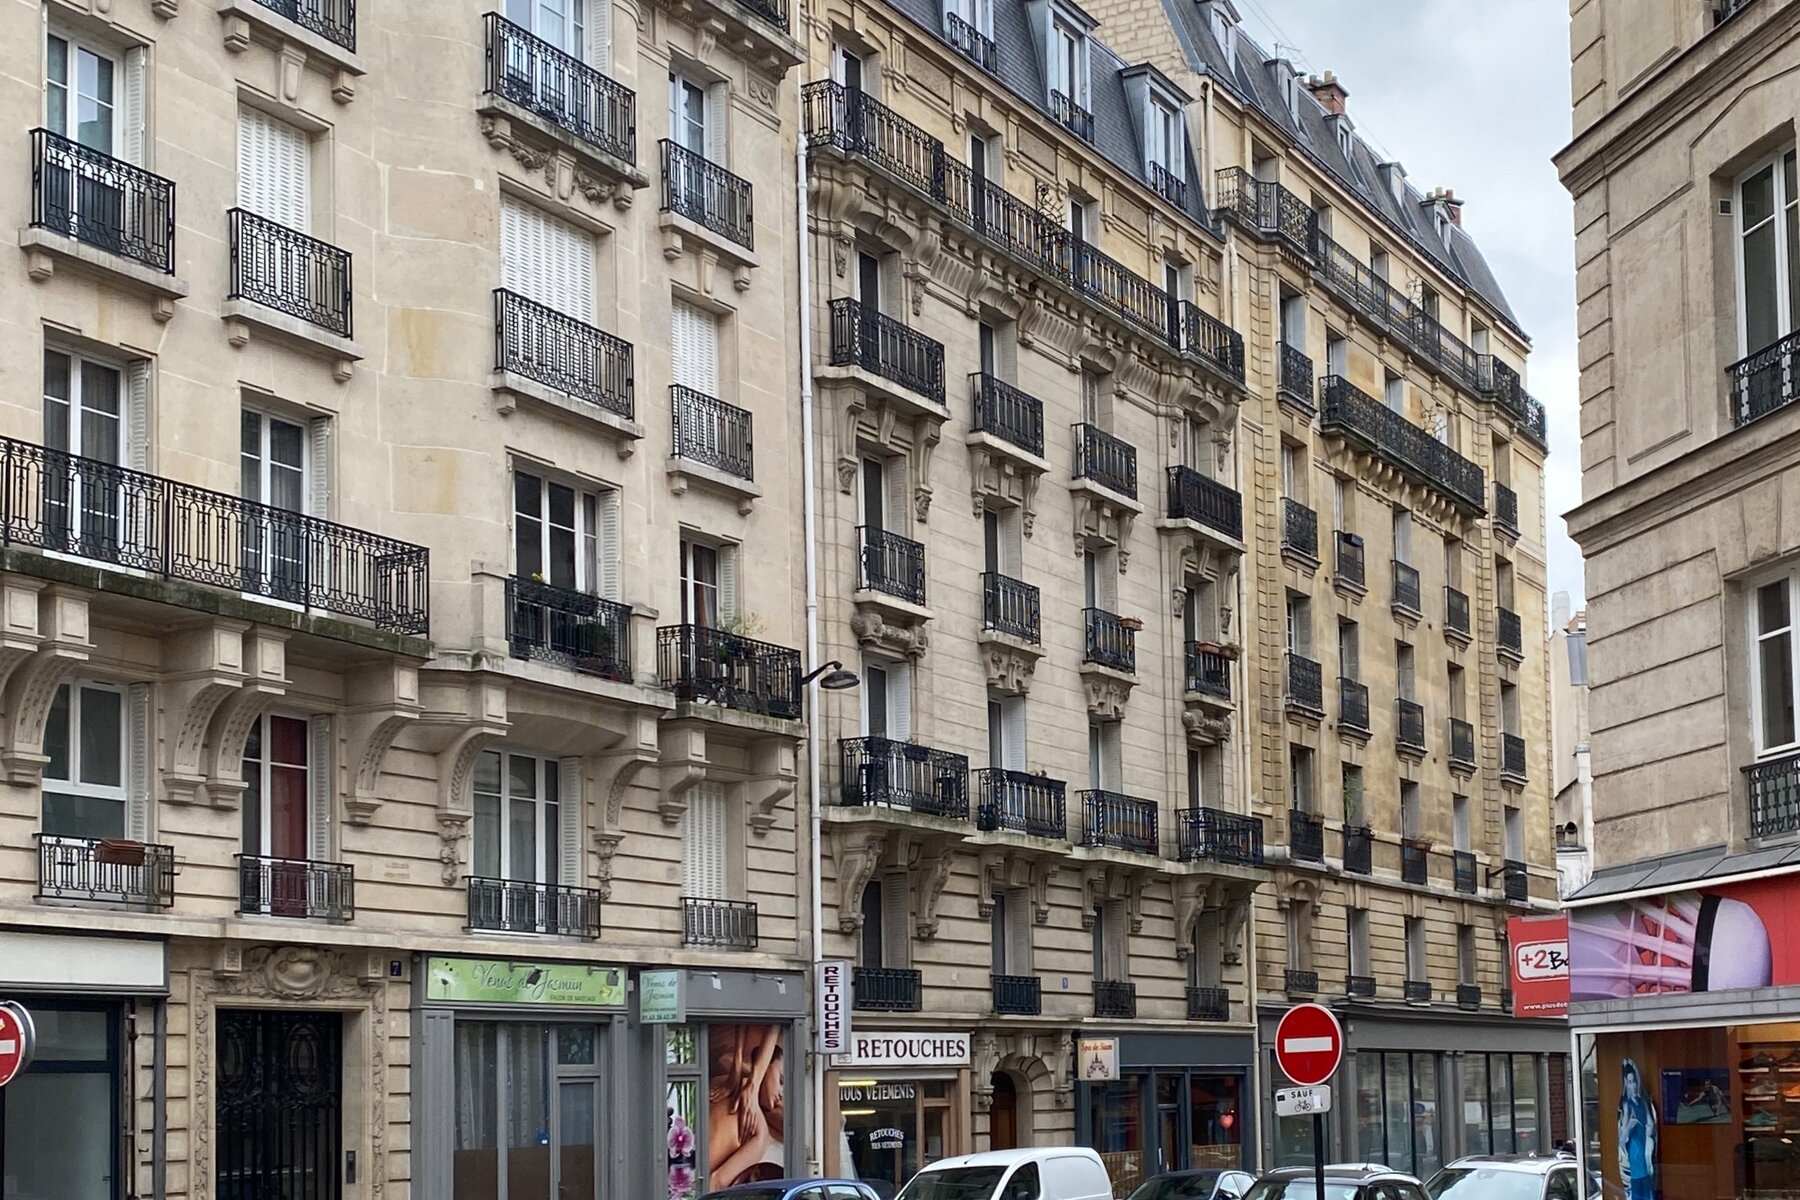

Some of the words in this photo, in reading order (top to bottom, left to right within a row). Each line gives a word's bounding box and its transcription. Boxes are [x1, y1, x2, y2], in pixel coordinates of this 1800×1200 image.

[824, 966, 840, 1048] RETOUCHES
[857, 1039, 965, 1058] RETOUCHES
[840, 1086, 862, 1101] TOUS
[1291, 1090, 1313, 1098] SAUF
[869, 1128, 904, 1141] RETOUCHES
